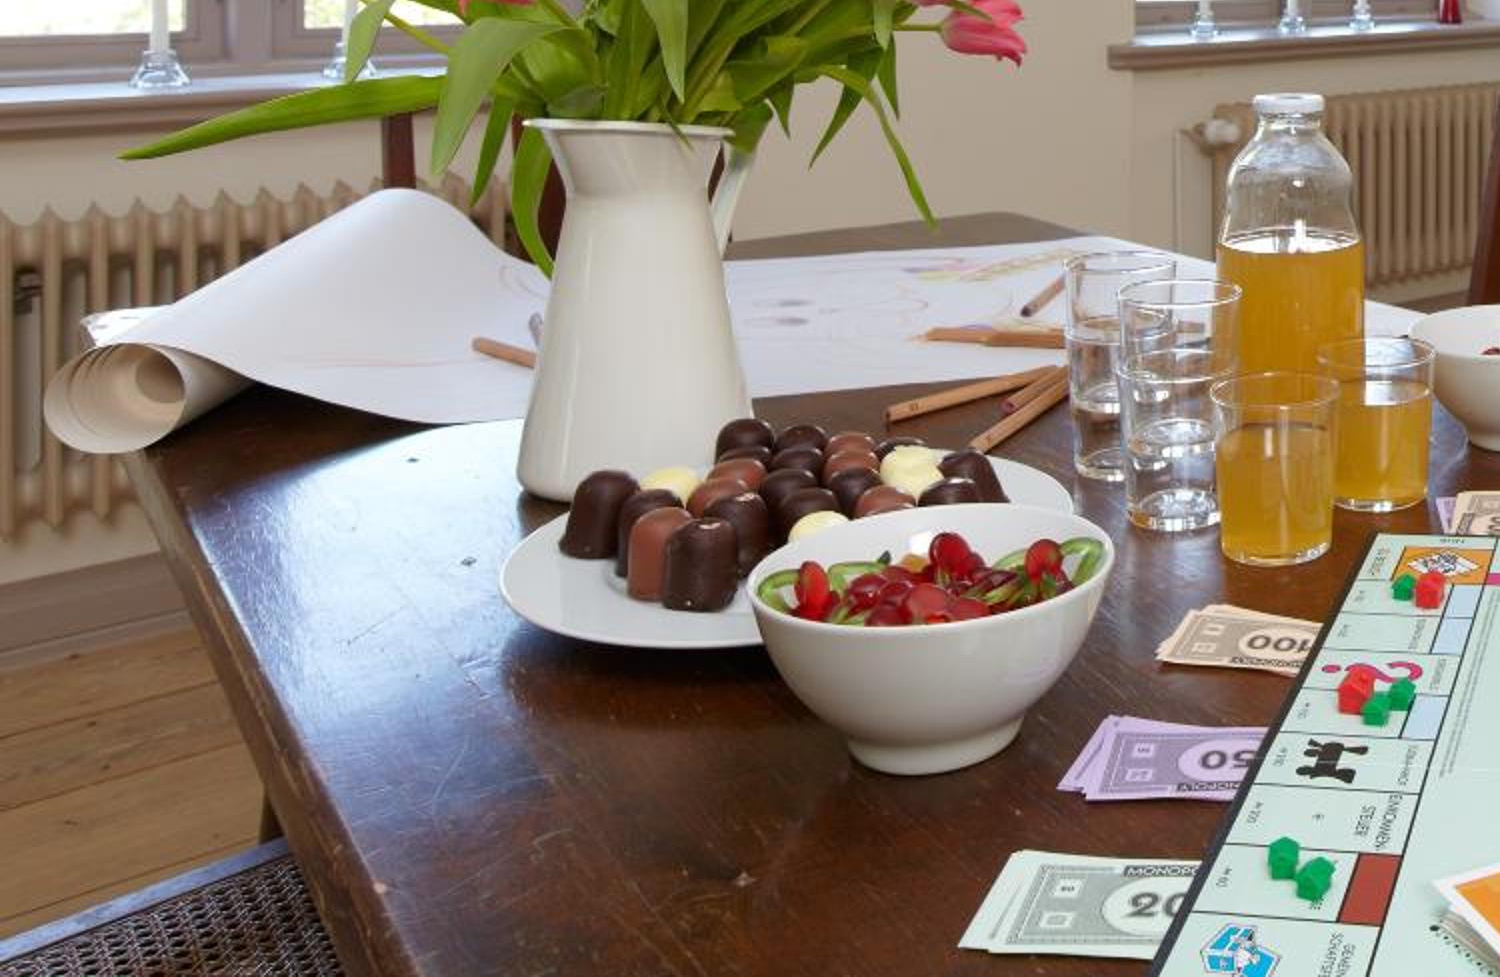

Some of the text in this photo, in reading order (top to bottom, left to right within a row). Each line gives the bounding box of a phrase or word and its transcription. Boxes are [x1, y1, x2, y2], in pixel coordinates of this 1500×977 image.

[1200, 750, 1258, 770] 50
[1354, 804, 1377, 838] STEUER
[1126, 892, 1188, 917] 20
